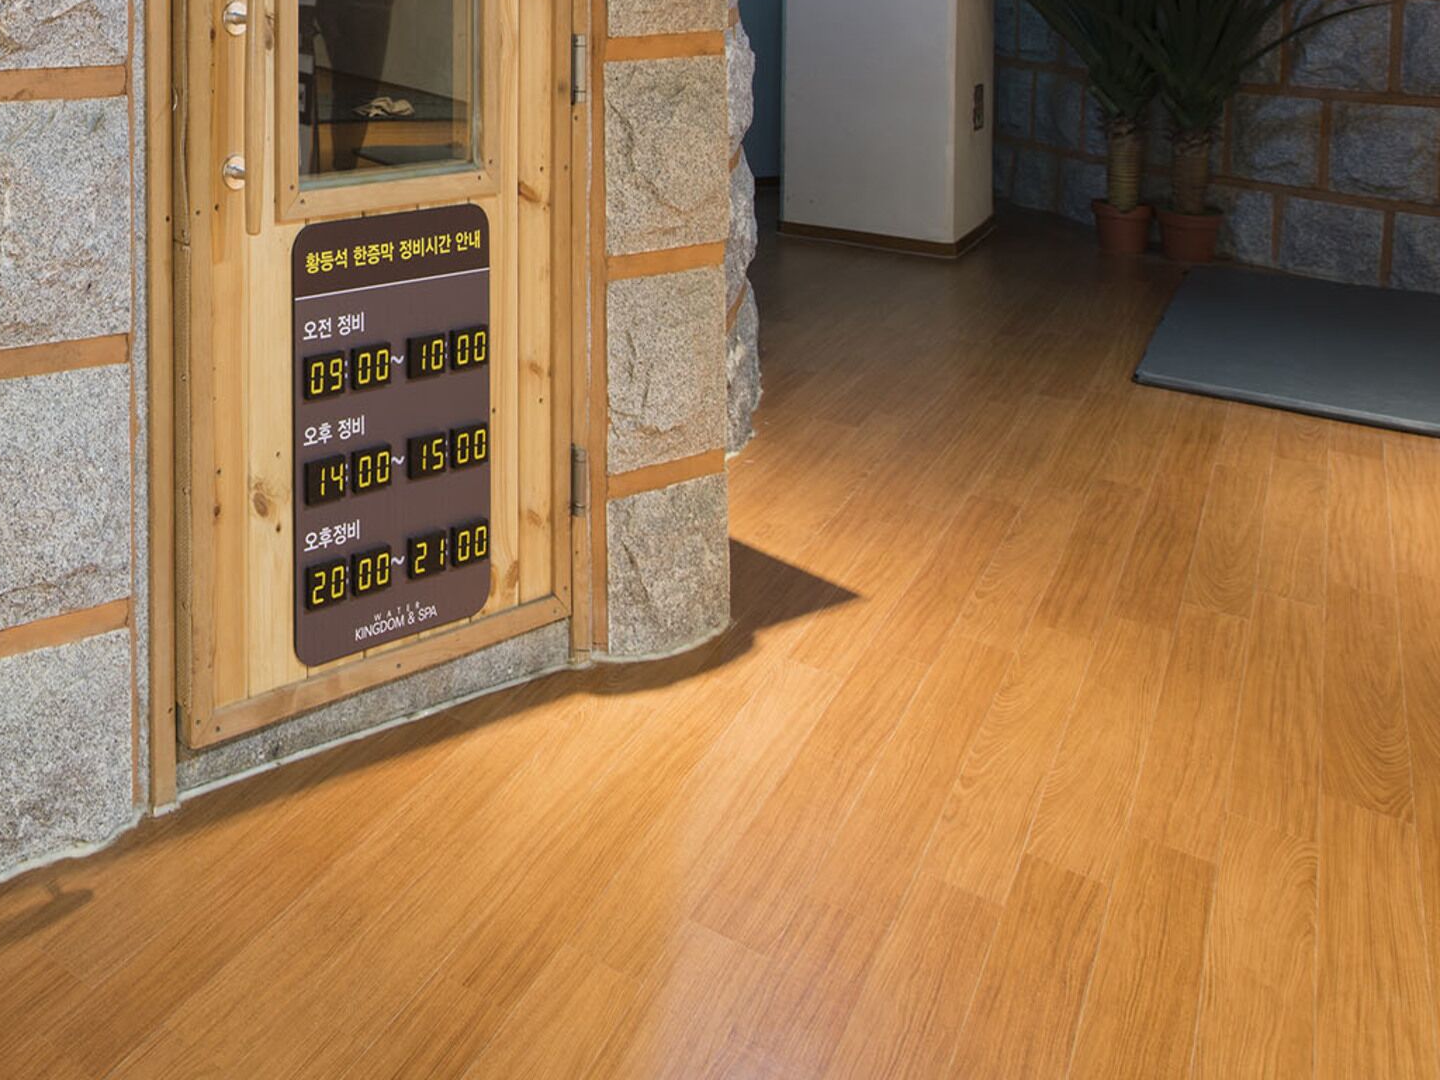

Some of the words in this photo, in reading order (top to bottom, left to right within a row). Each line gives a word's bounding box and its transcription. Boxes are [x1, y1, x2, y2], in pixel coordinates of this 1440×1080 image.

[305, 248, 348, 274] 황등석
[353, 242, 394, 267] 한증막
[399, 234, 452, 260] 정비시간
[455, 230, 481, 251] 안내
[303, 317, 332, 340] 오전
[337, 312, 365, 336] 정비
[303, 422, 333, 446] 오후
[337, 415, 365, 440] 정비
[304, 519, 360, 552] 오후정비
[354, 614, 405, 640] KINGDOM
[407, 611, 415, 625] &
[418, 604, 438, 621] SPA
